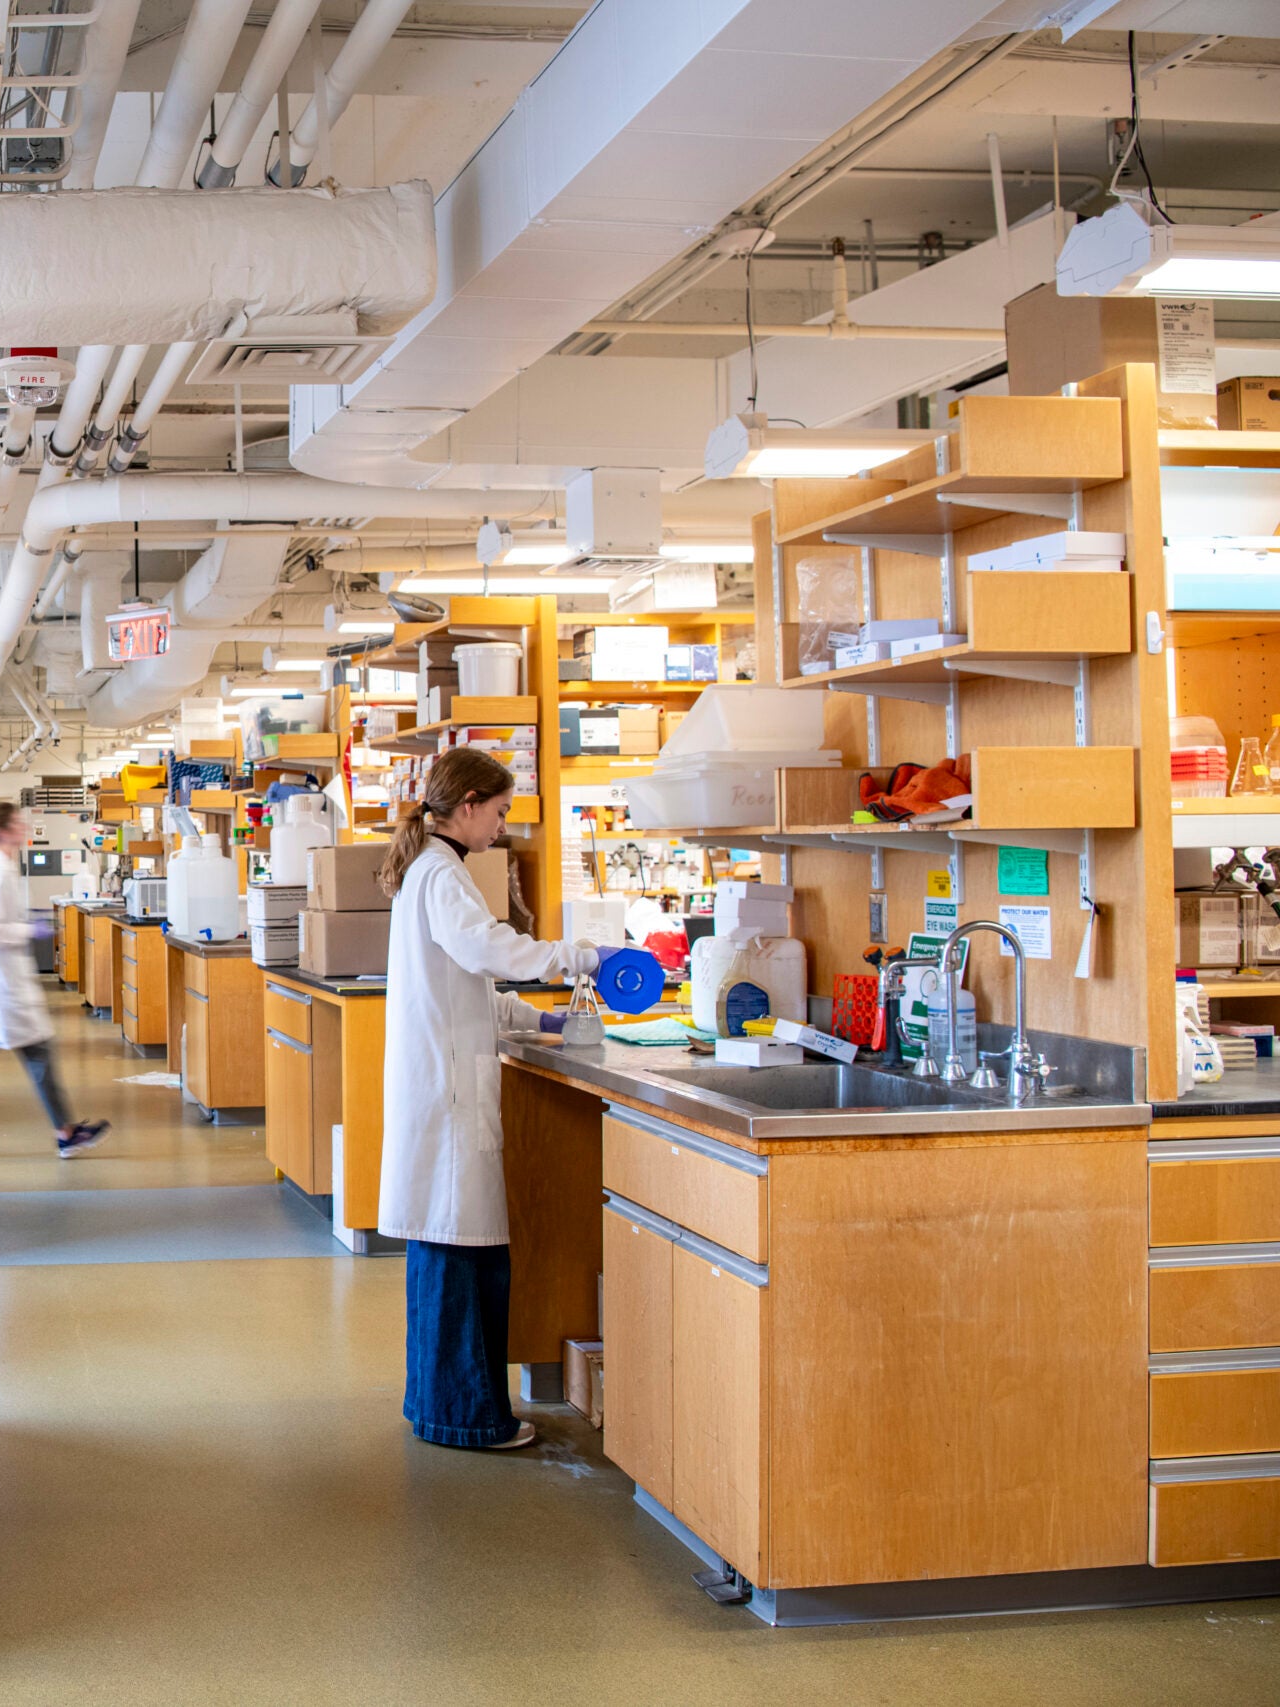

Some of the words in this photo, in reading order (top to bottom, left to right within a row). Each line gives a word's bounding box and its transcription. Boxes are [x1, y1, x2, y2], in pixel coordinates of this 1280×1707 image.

[20, 376, 45, 384] FIRE
[120, 618, 160, 656] EXIT
[927, 904, 955, 914] EMERGENCY
[927, 920, 938, 931] EYE
[939, 921, 956, 932] WASH
[912, 941, 937, 952] Emergency
